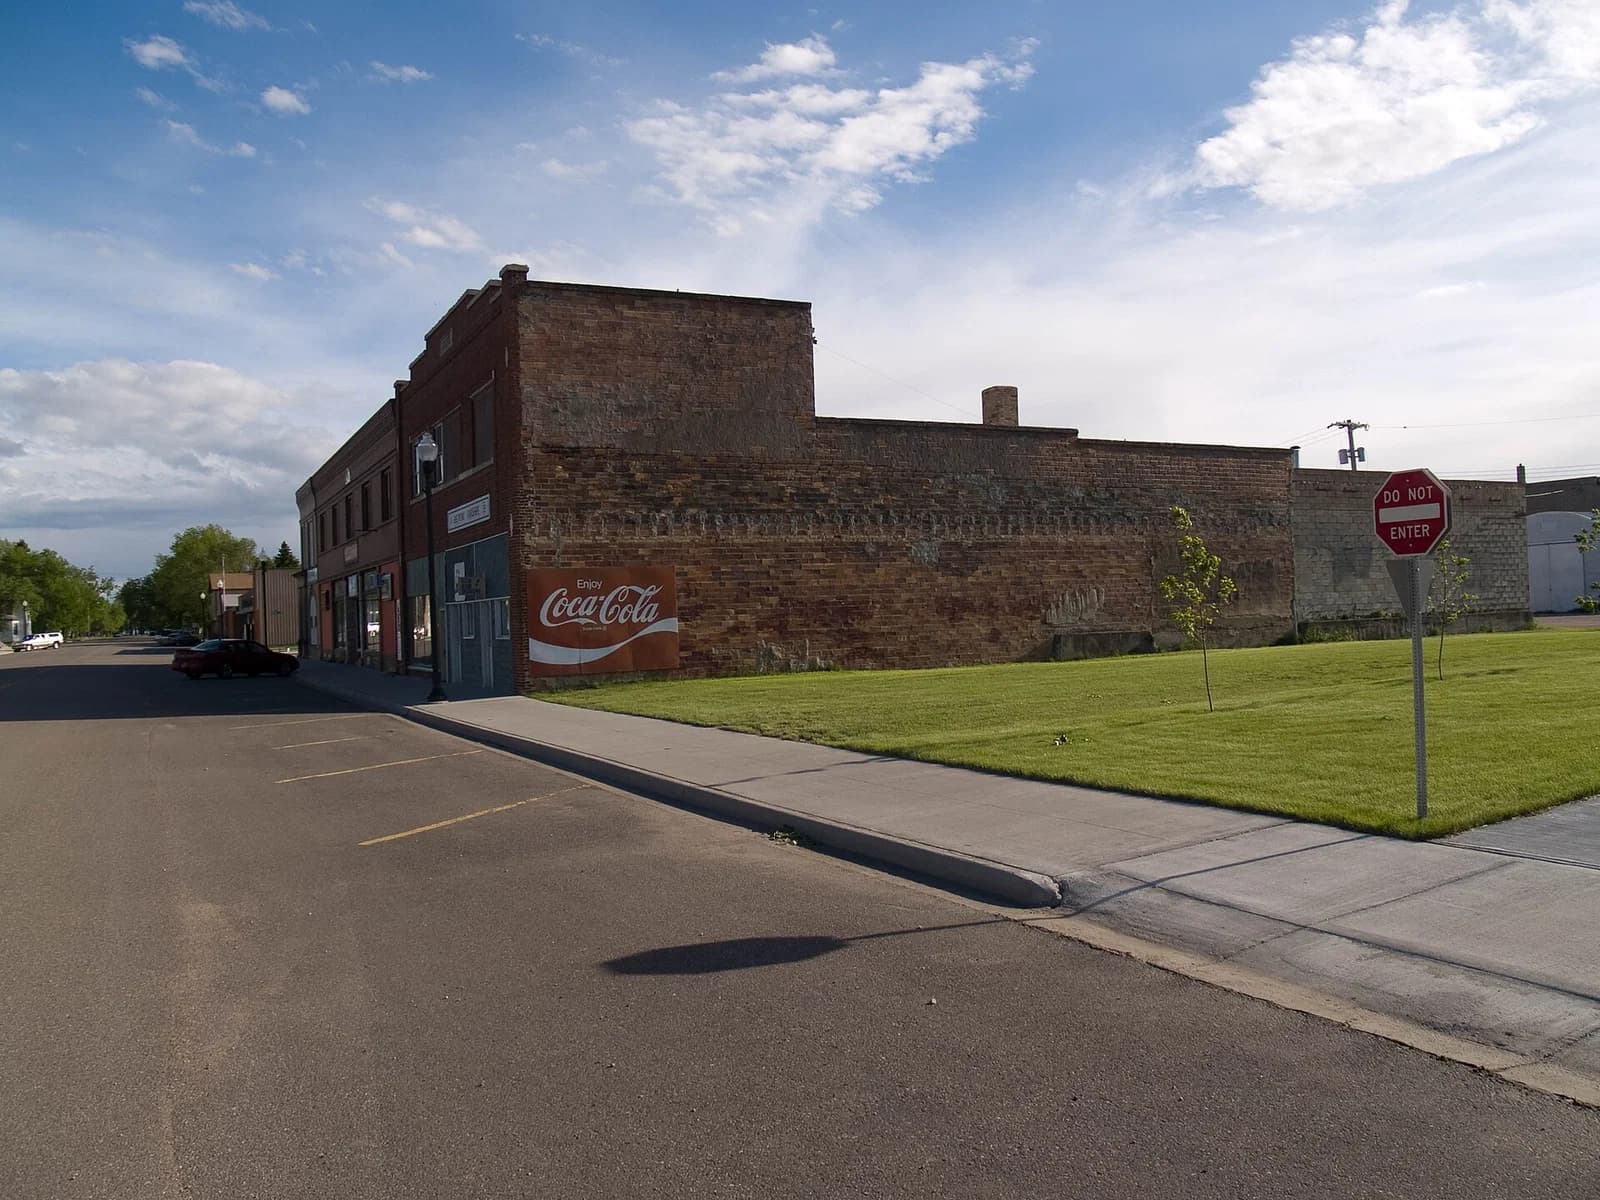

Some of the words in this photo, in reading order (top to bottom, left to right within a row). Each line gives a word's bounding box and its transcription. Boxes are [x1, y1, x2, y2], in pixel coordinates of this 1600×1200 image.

[1383, 489, 1400, 504] DO
[1408, 485, 1433, 501] NOT
[1390, 524, 1430, 540] ENTER
[577, 579, 602, 591] Enjoy
[539, 584, 664, 627] Coca-Cola
